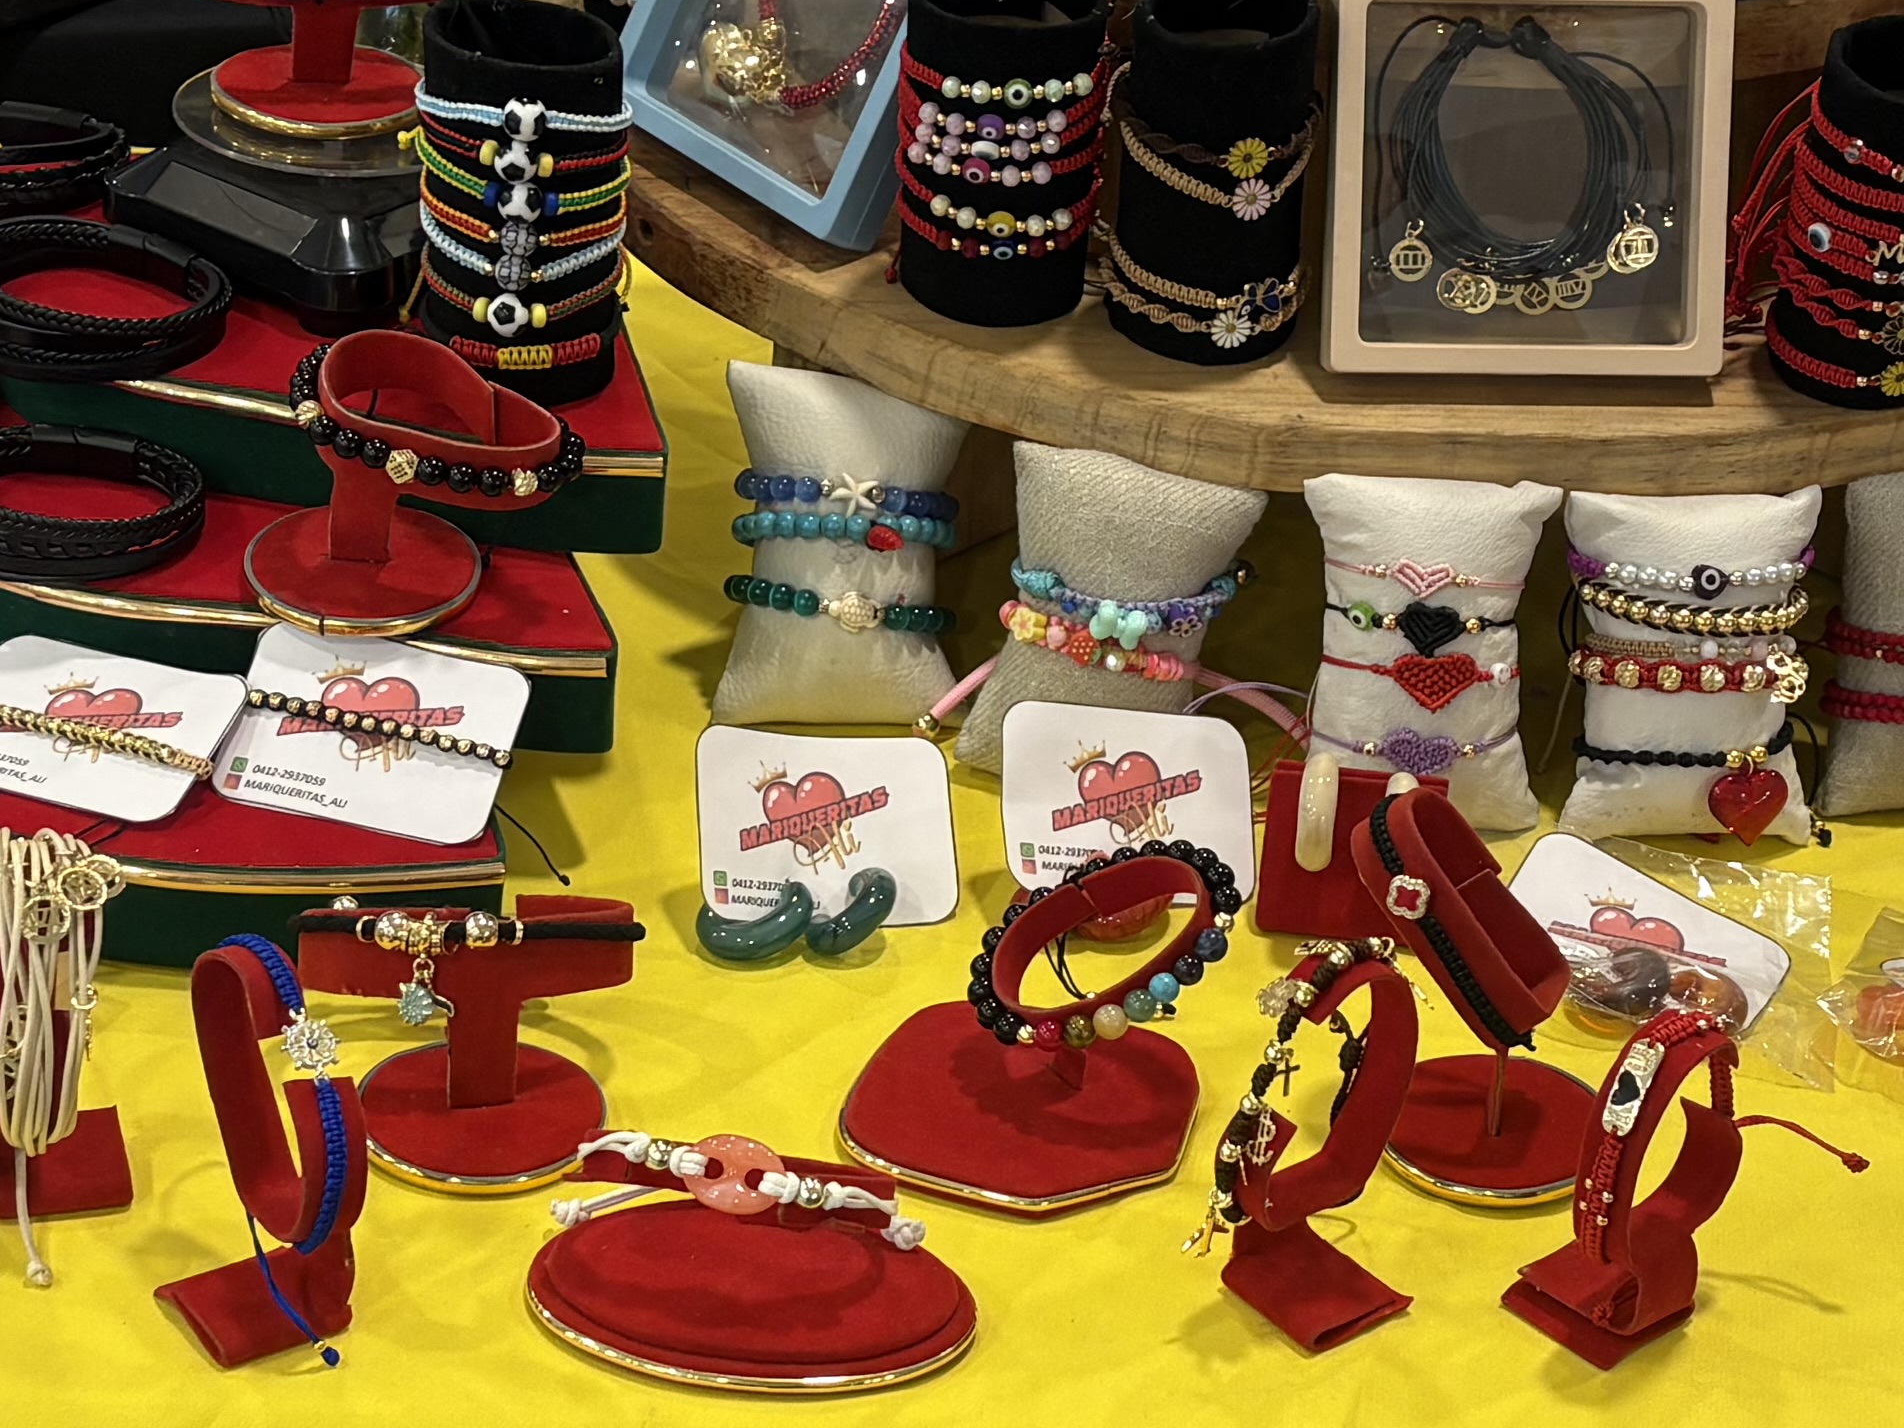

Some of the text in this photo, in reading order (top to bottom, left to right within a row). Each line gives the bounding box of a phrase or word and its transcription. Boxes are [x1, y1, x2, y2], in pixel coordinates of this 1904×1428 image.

[252, 764, 326, 786] 0412-2937059
[1052, 769, 1202, 832] MARIQUERITAS
[740, 785, 889, 851] MARIQUERITAS
